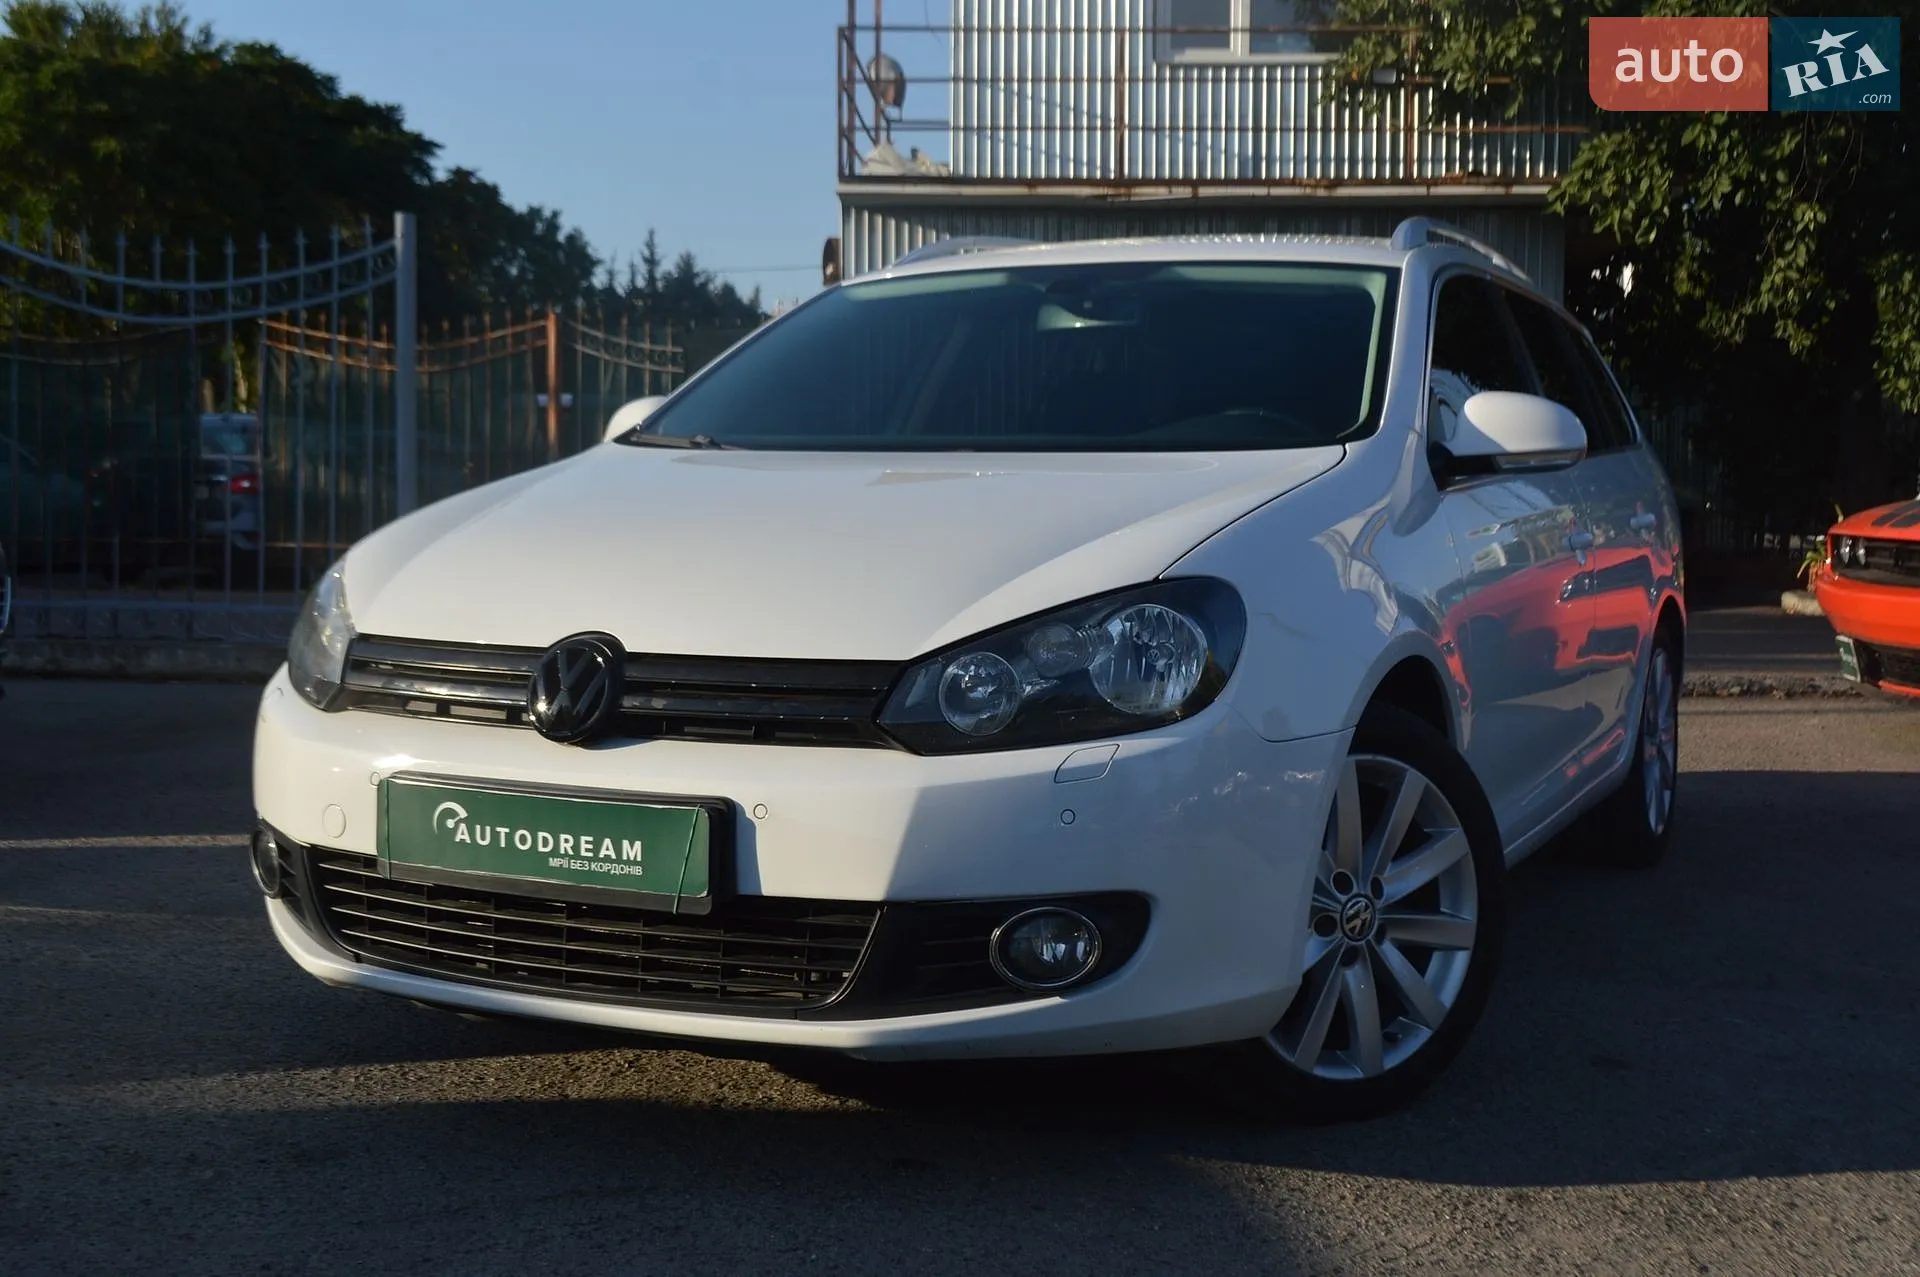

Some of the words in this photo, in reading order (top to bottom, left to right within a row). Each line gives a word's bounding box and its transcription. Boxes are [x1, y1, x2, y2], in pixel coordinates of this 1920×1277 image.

[454, 822, 642, 861] AUTODREAM
[570, 859, 590, 871] БЕЗ
[591, 861, 643, 876] КОРДОНІВ
